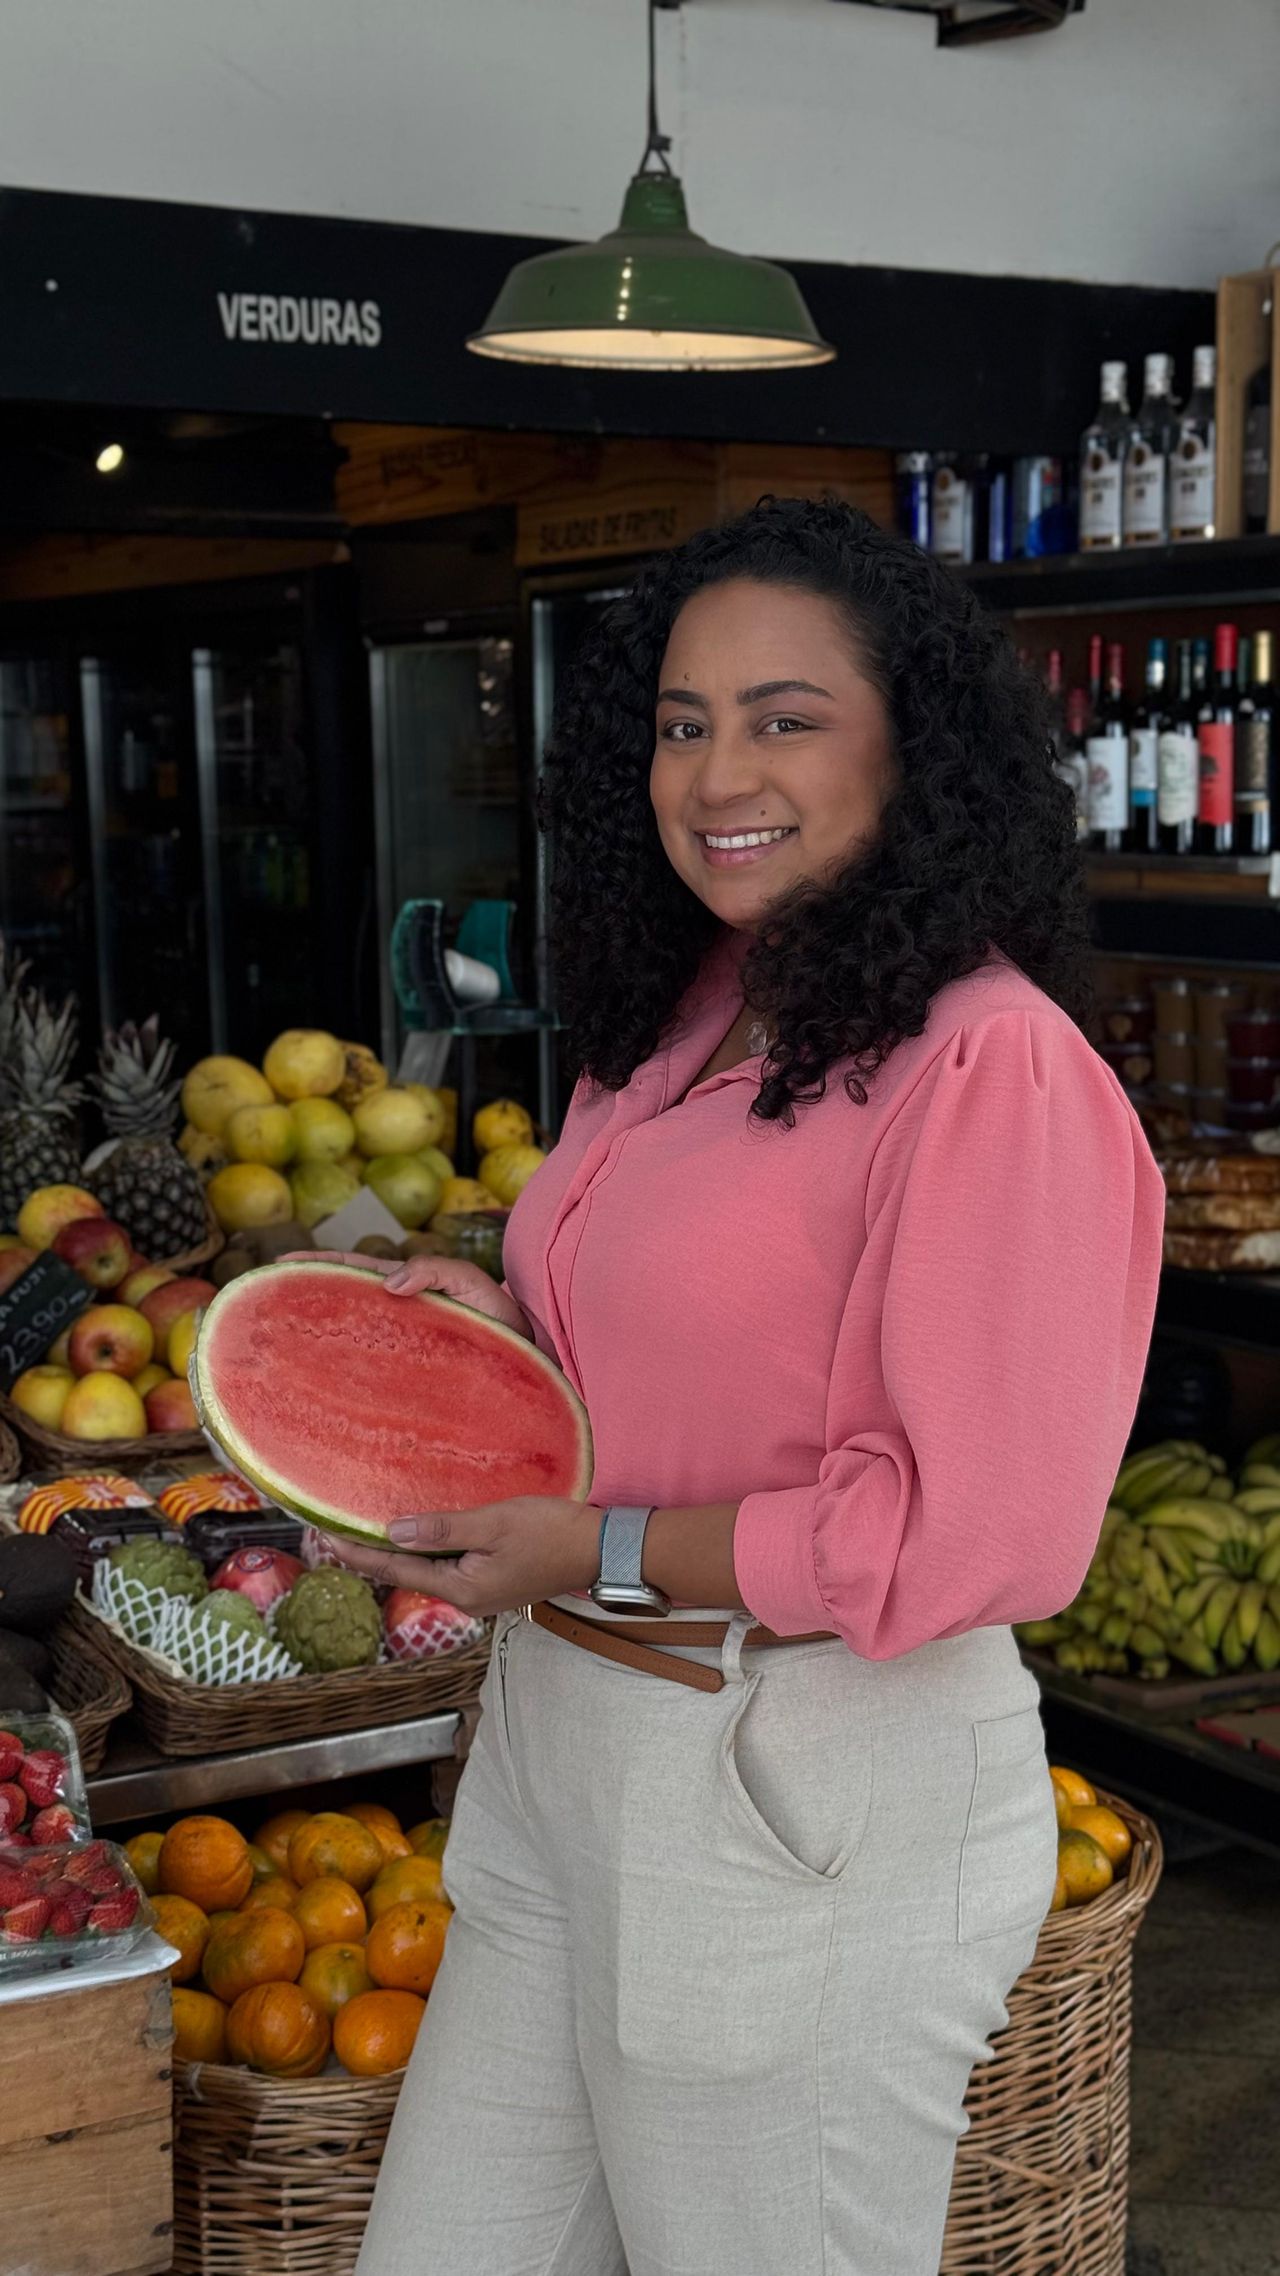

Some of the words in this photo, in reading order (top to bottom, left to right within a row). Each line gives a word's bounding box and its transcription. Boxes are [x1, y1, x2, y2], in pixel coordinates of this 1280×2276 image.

[217, 292, 382, 346] VERDURAS
[603, 512, 622, 545] DE
[9, 1266, 47, 1304] FUJI
